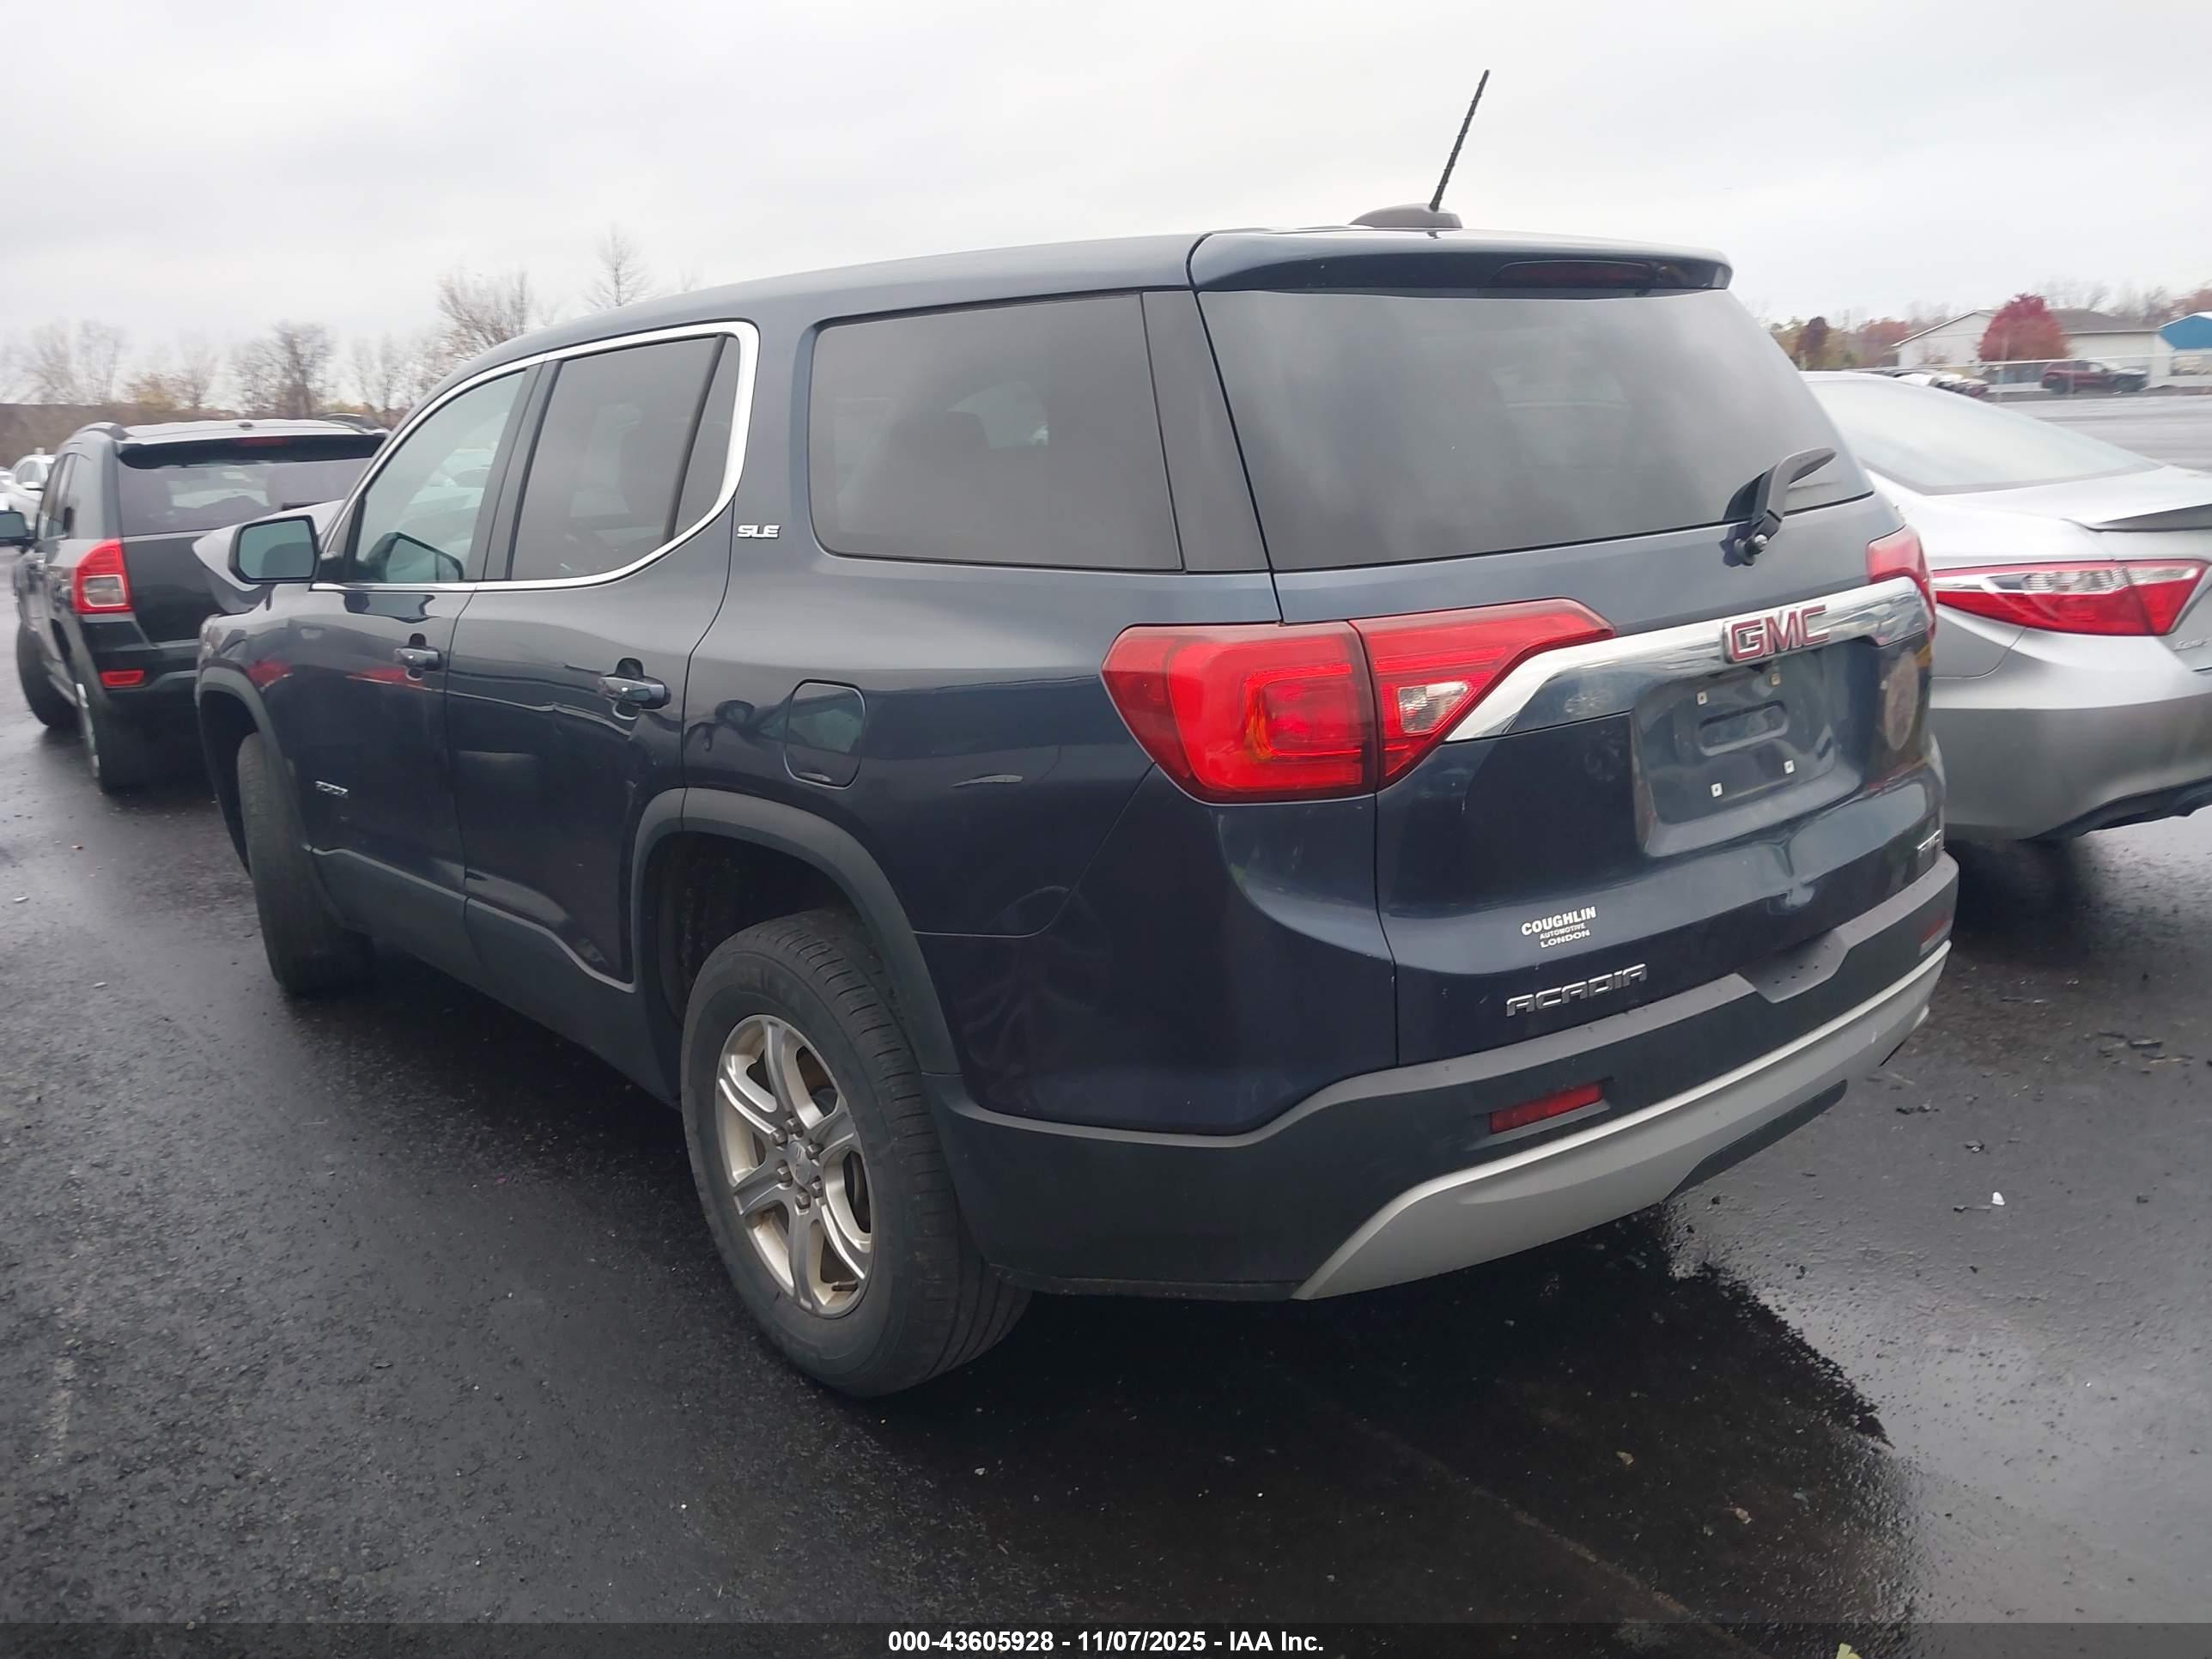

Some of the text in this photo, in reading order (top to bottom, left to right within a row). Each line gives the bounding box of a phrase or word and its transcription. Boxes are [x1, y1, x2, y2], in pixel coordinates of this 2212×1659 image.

[737, 525, 781, 538] SLE
[1729, 604, 1830, 662] GMC
[1521, 906, 1597, 936] COUGHLIN
[1539, 922, 1587, 940] AUTOMOTIVE
[1540, 929, 1590, 949] LONDON
[1505, 963, 1648, 1018] ACADIA
